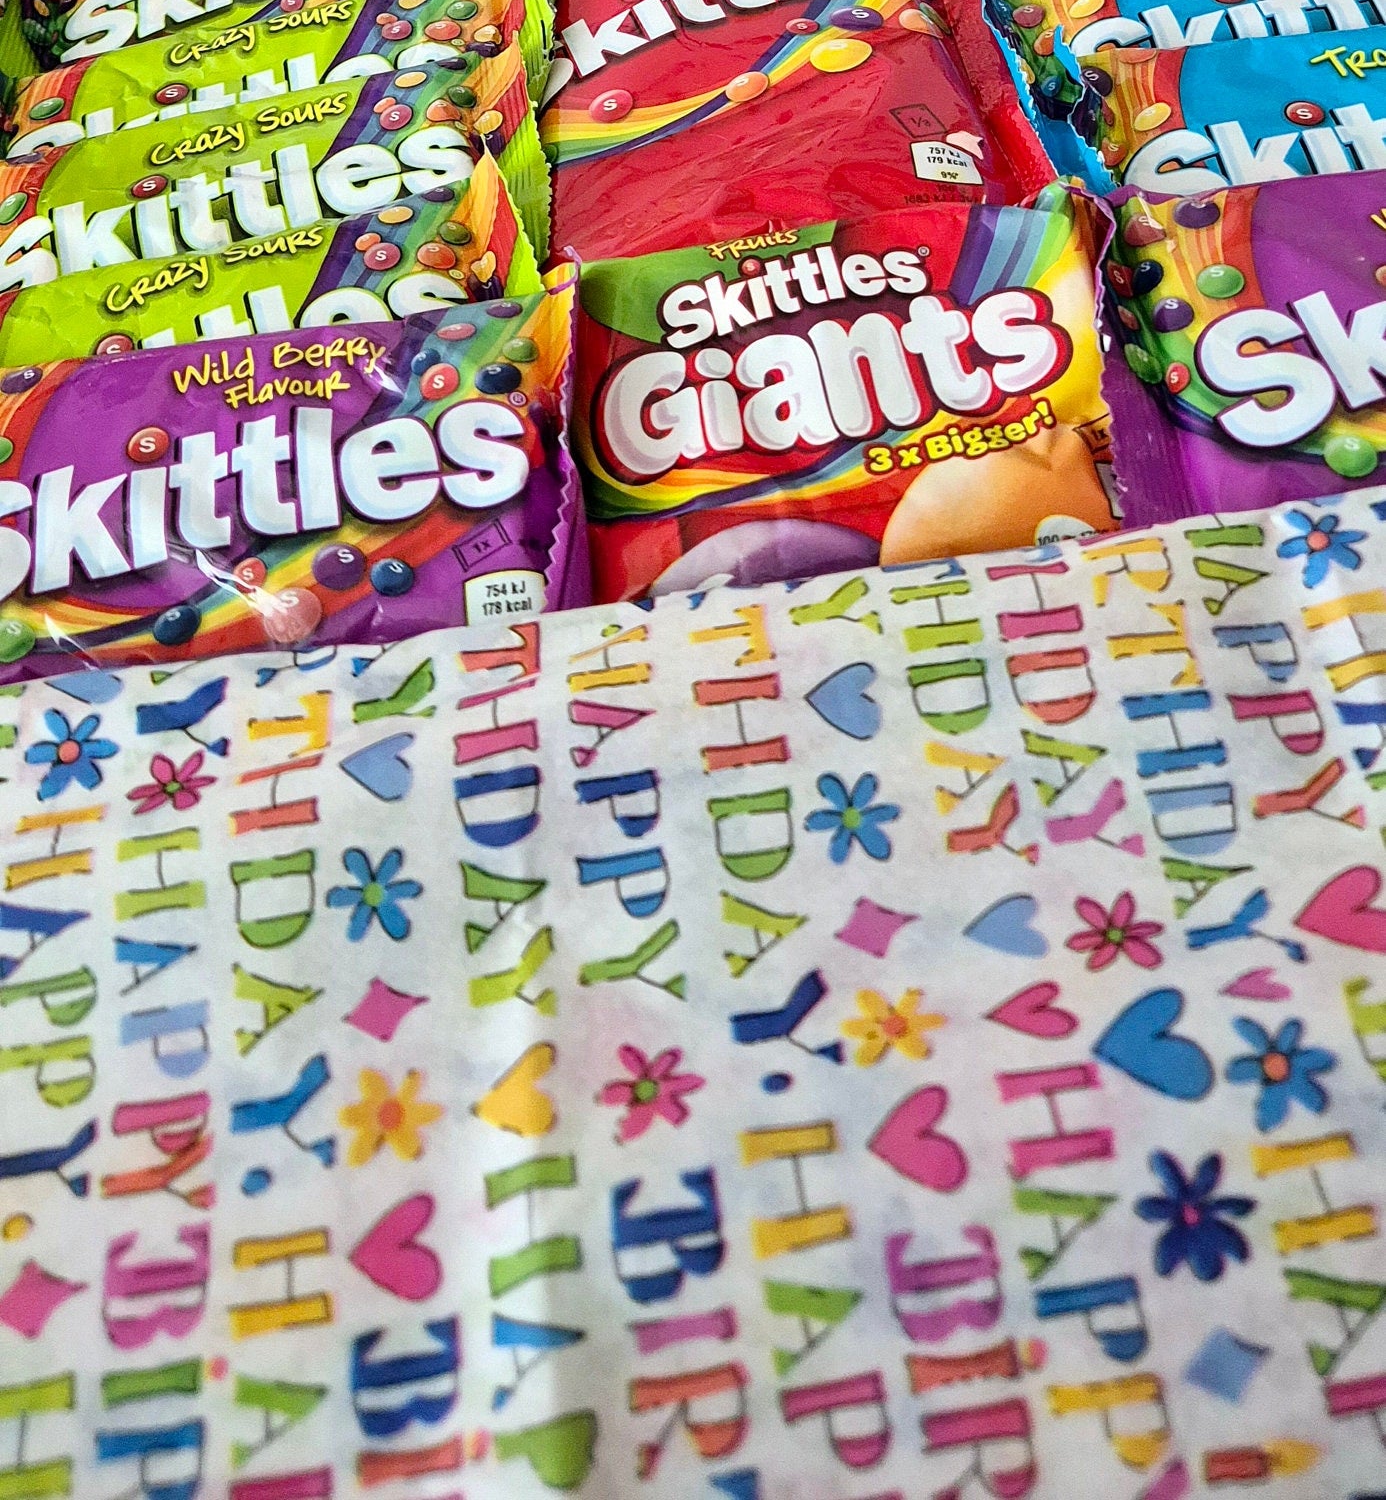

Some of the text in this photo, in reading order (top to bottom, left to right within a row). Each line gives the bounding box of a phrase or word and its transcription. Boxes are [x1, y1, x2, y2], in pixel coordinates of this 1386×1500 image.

[169, 24, 255, 66] Crazy
[150, 117, 245, 165] Crazy
[257, 92, 350, 134] Sours
[107, 256, 209, 313] Crazy
[224, 224, 326, 265] Sours
[708, 227, 800, 261] Fruits
[663, 245, 928, 350] Skittles
[173, 337, 386, 395] Wild Berry
[224, 371, 350, 410] Flavour
[604, 292, 1059, 475] Giants
[869, 399, 1055, 472] 3 x Bigger!
[481, 596, 532, 616] 178 kcal
[485, 580, 527, 598] 754 kJ
[568, 624, 691, 1001] HAPPY
